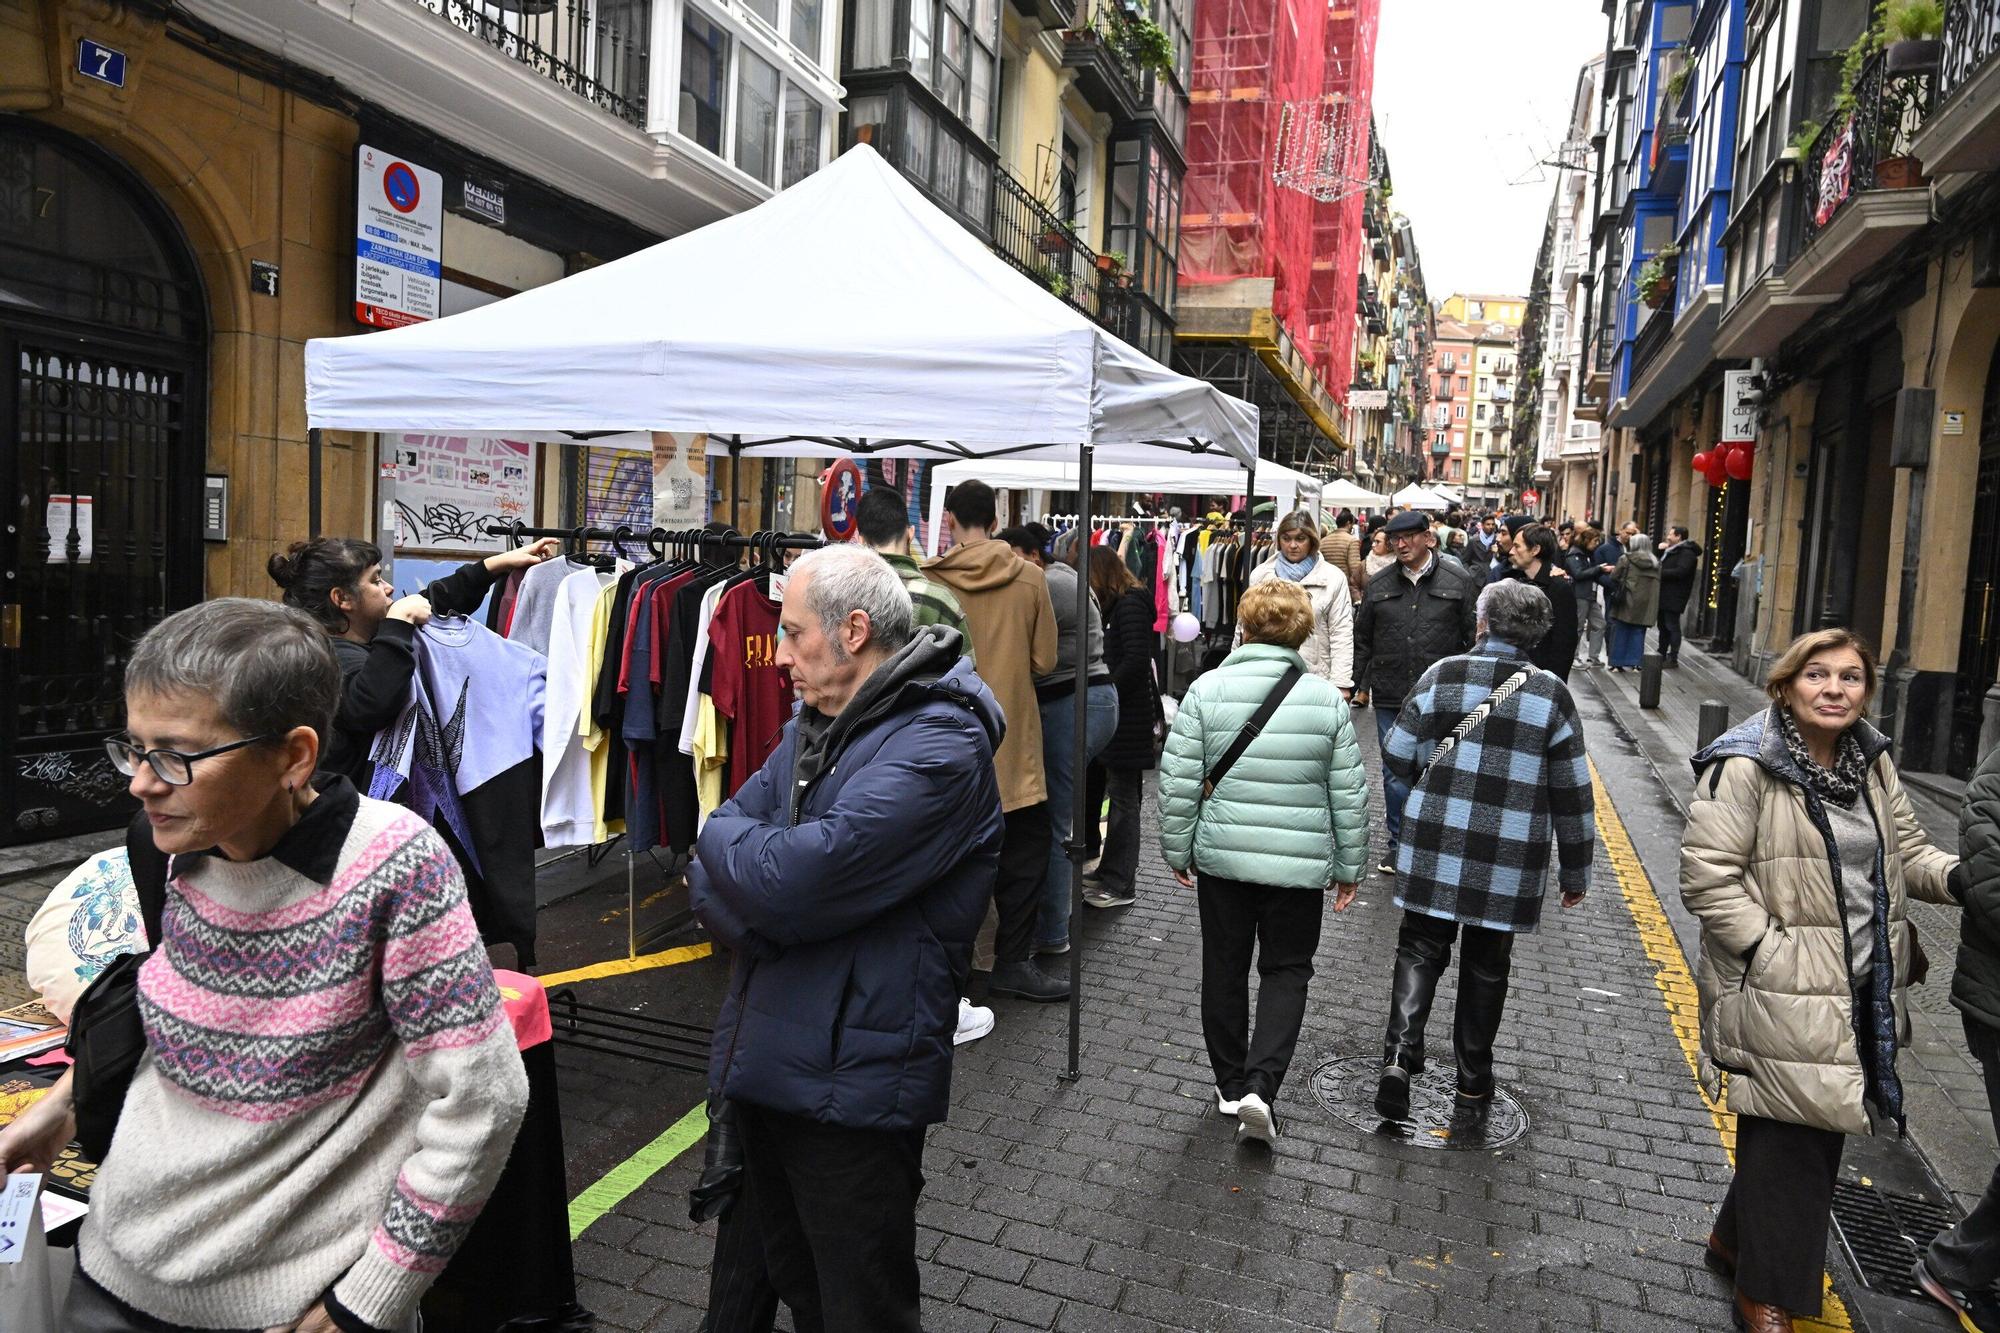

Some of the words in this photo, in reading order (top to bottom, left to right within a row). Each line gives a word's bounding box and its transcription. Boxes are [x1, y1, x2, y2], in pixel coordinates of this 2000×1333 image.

[95, 48, 112, 77] 7
[36, 187, 55, 217] 7
[466, 181, 502, 203] VENDE
